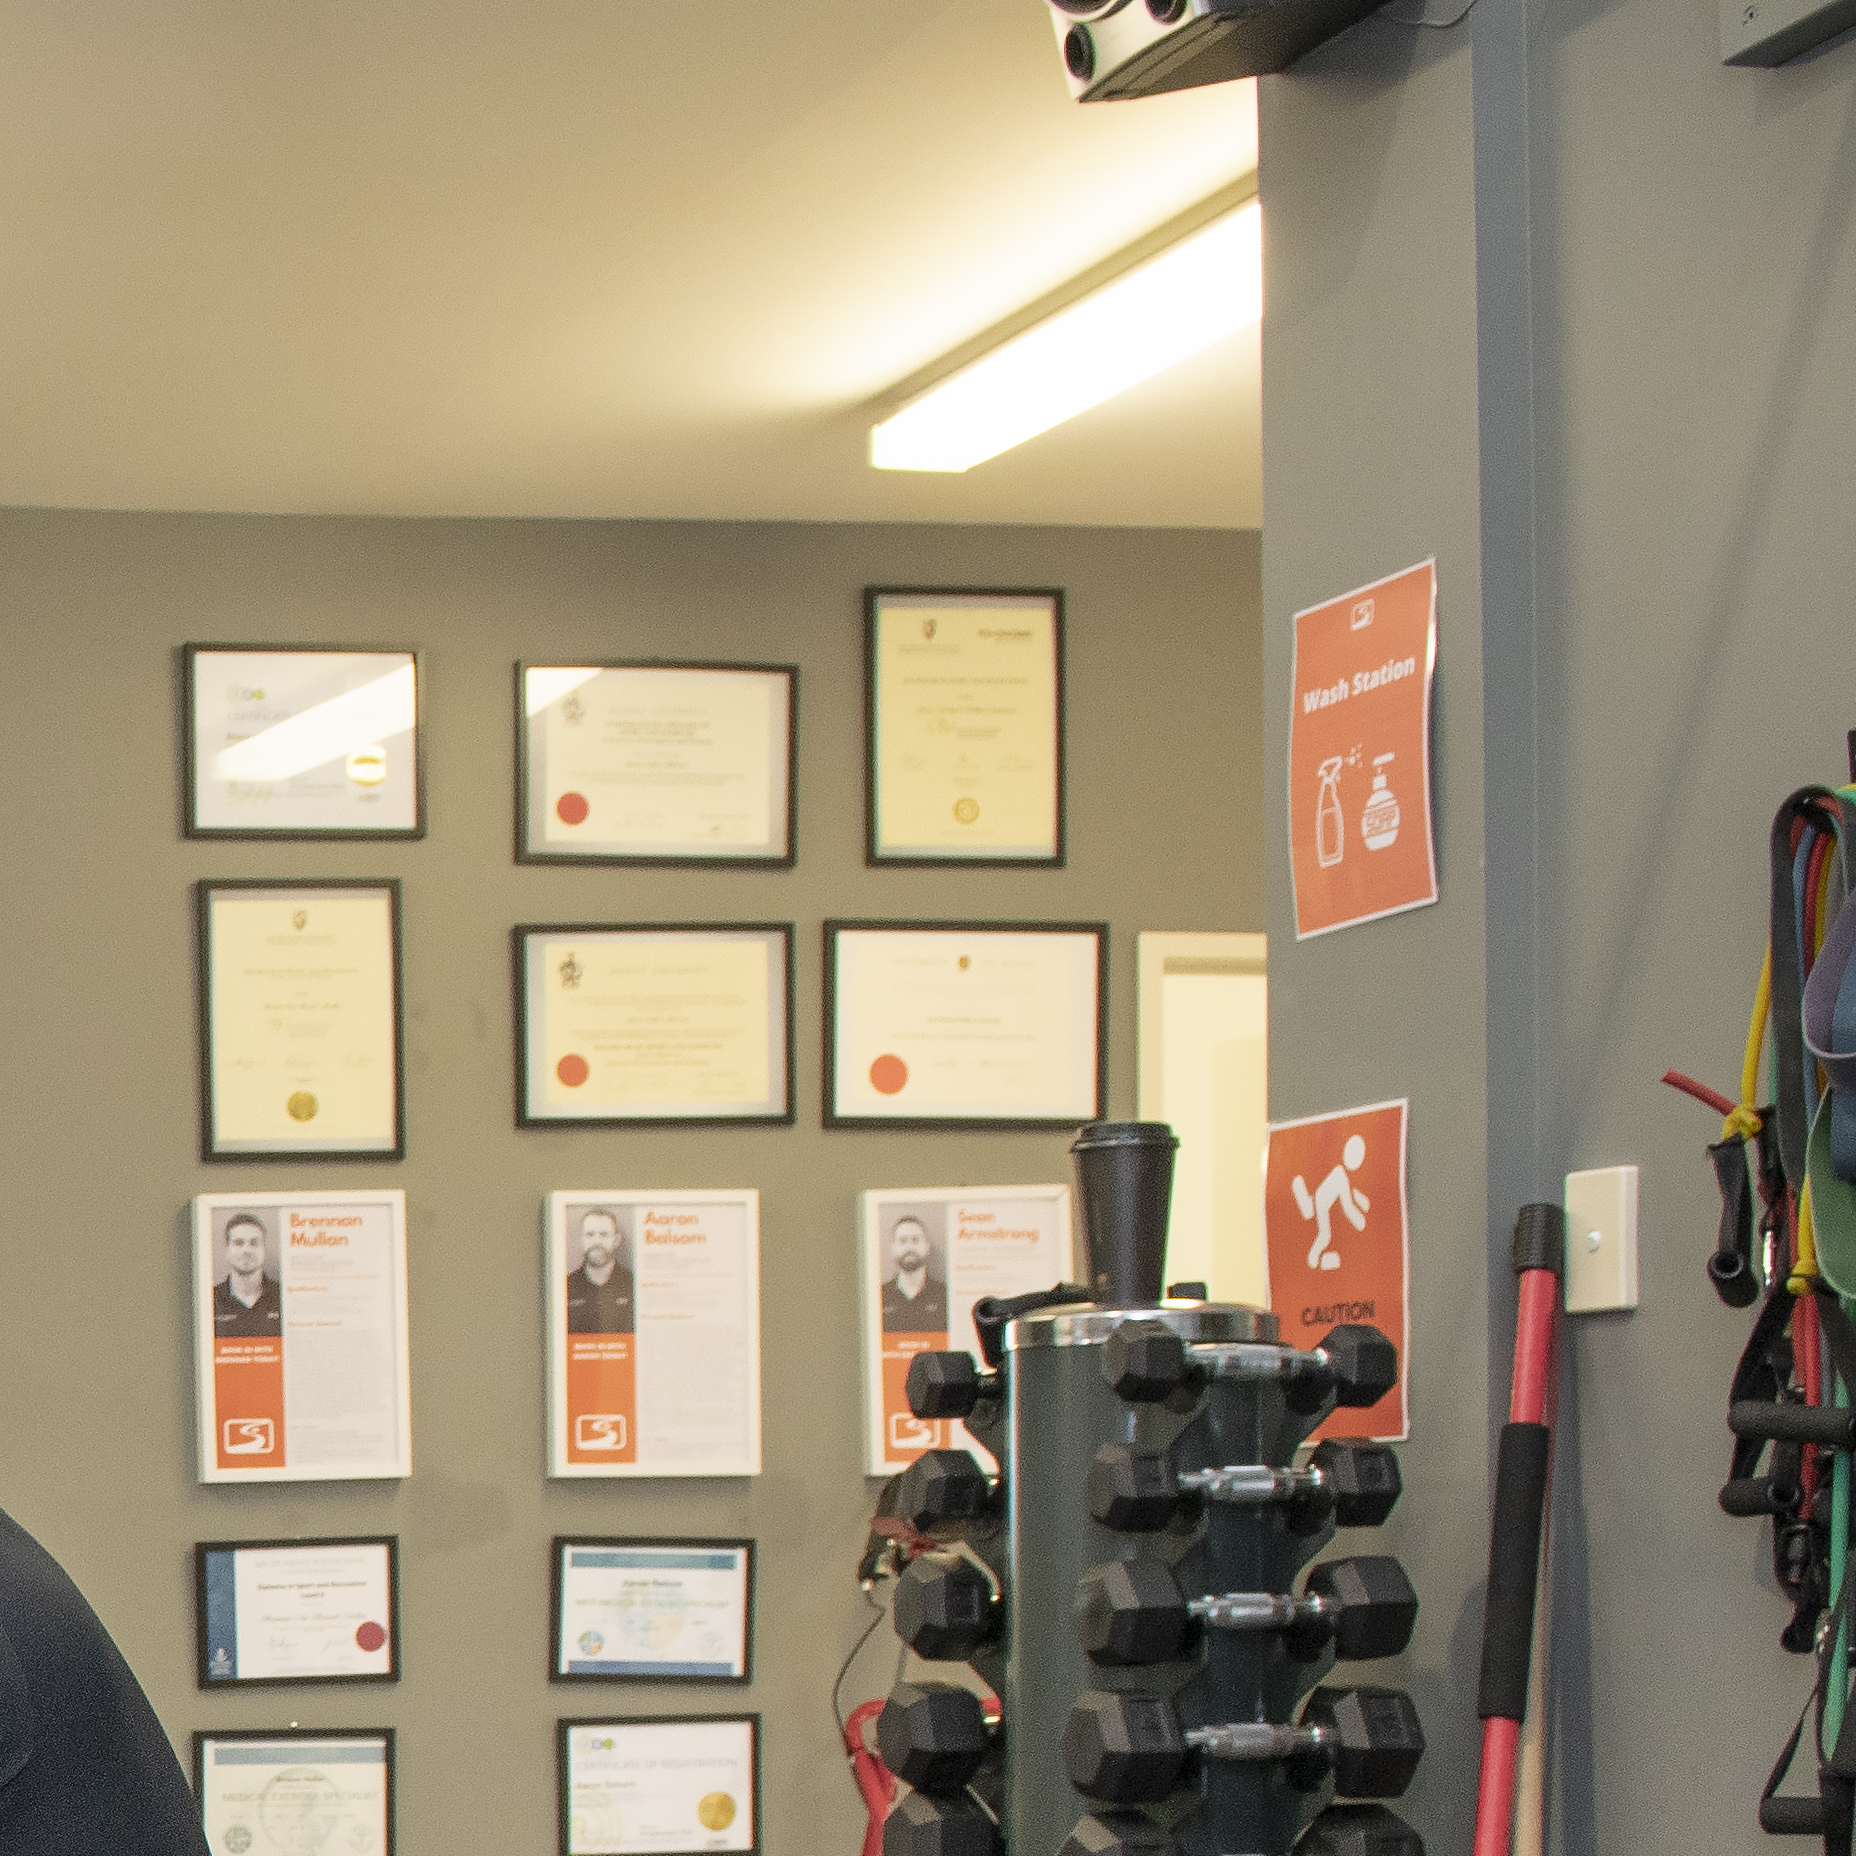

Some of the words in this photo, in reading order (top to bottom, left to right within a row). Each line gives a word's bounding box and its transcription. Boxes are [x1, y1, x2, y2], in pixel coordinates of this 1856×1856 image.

[1302, 677, 1350, 714] Wash
[1351, 655, 1417, 697] Station
[1300, 1299, 1375, 1328] CAUTION
